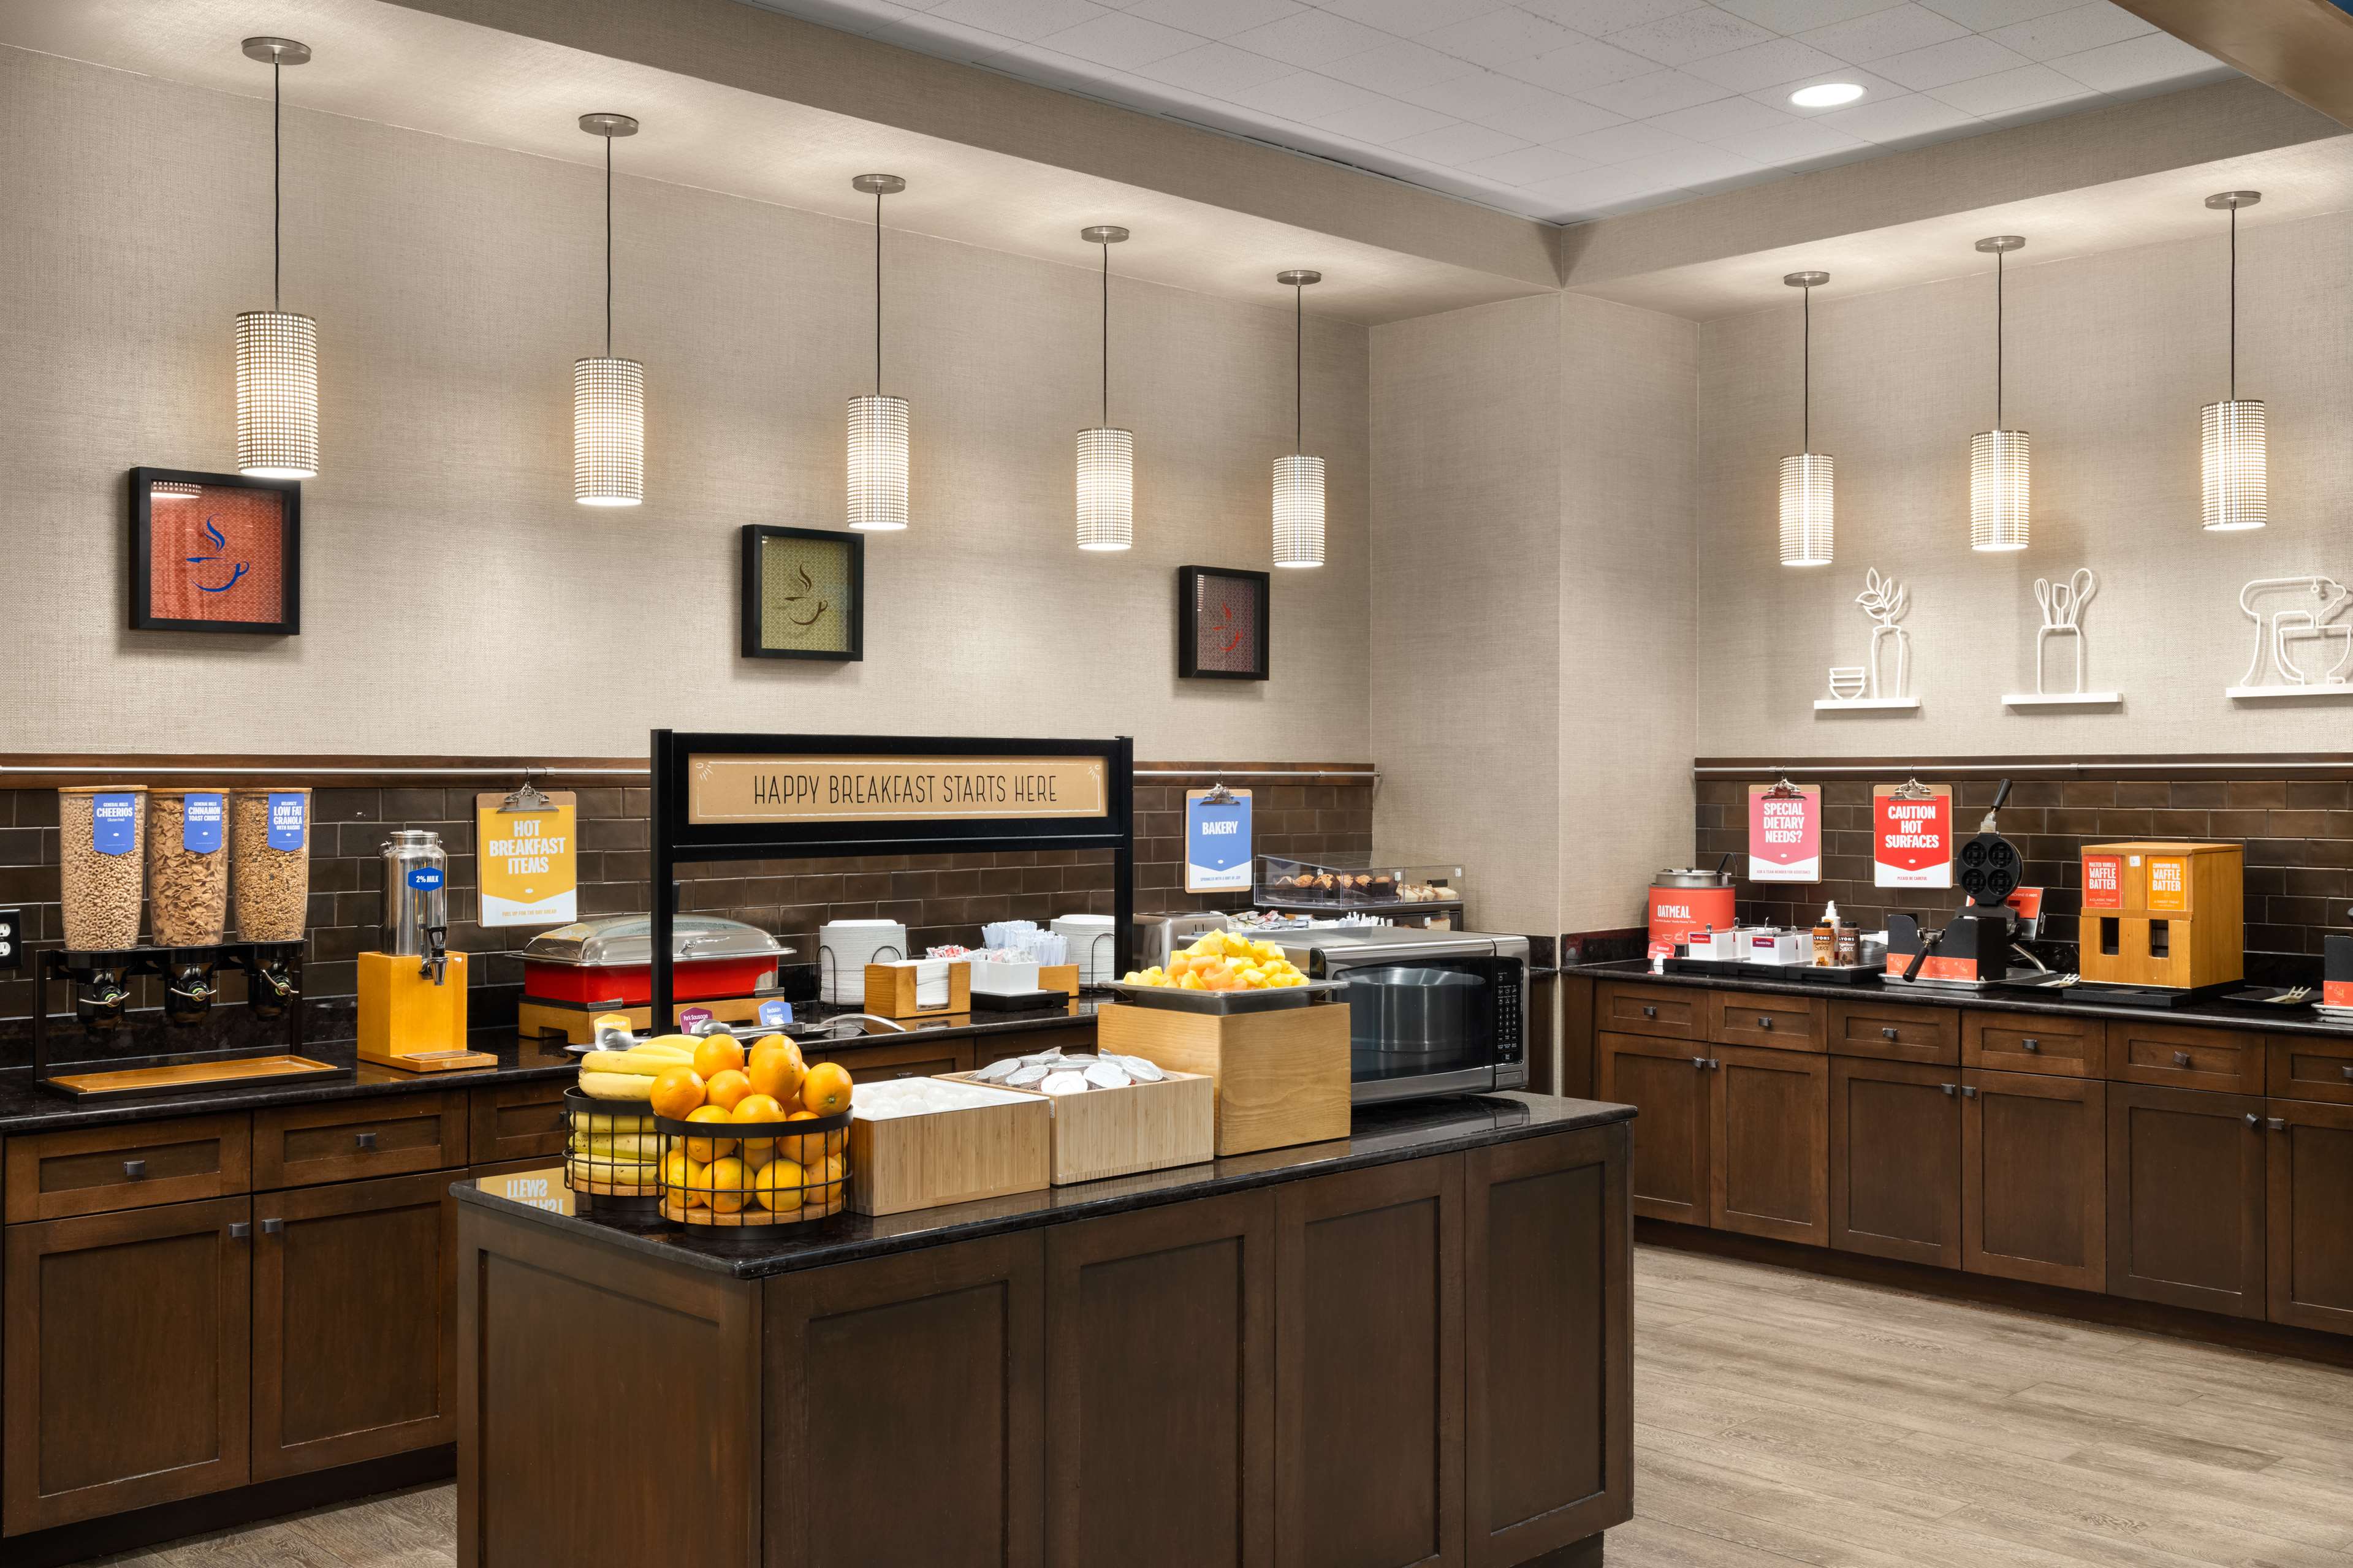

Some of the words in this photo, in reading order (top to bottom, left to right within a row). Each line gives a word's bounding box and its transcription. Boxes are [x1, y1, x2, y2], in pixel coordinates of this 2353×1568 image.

[755, 775, 819, 804] HAPPY
[830, 775, 935, 803] BREAKFAST
[943, 776, 1005, 803] STARTS
[1015, 776, 1057, 802] HERE
[96, 807, 133, 817] CHEERIOS
[188, 806, 221, 815] CINNAMON
[273, 806, 291, 816] LOW
[291, 806, 303, 816] FAT
[1764, 803, 1804, 815] SPECIAL
[1888, 806, 1936, 819] CAUTION
[273, 816, 302, 825] GRANOLA
[1763, 816, 1805, 829] DIETARY
[1901, 820, 1923, 834] HOT
[514, 820, 541, 837] HOT
[1202, 821, 1238, 835] BAKERY
[1765, 830, 1803, 843] NEEDS?
[1885, 835, 1939, 848] SURFACES
[489, 837, 566, 857] BREAKFAST
[507, 857, 549, 874] ITEMS
[2089, 868, 2116, 879] WAFFLE
[2153, 869, 2181, 880] WAFFLE
[2089, 879, 2116, 890] BATTER
[2153, 880, 2181, 892] BATTER
[1657, 905, 1691, 918] OATMEAL
